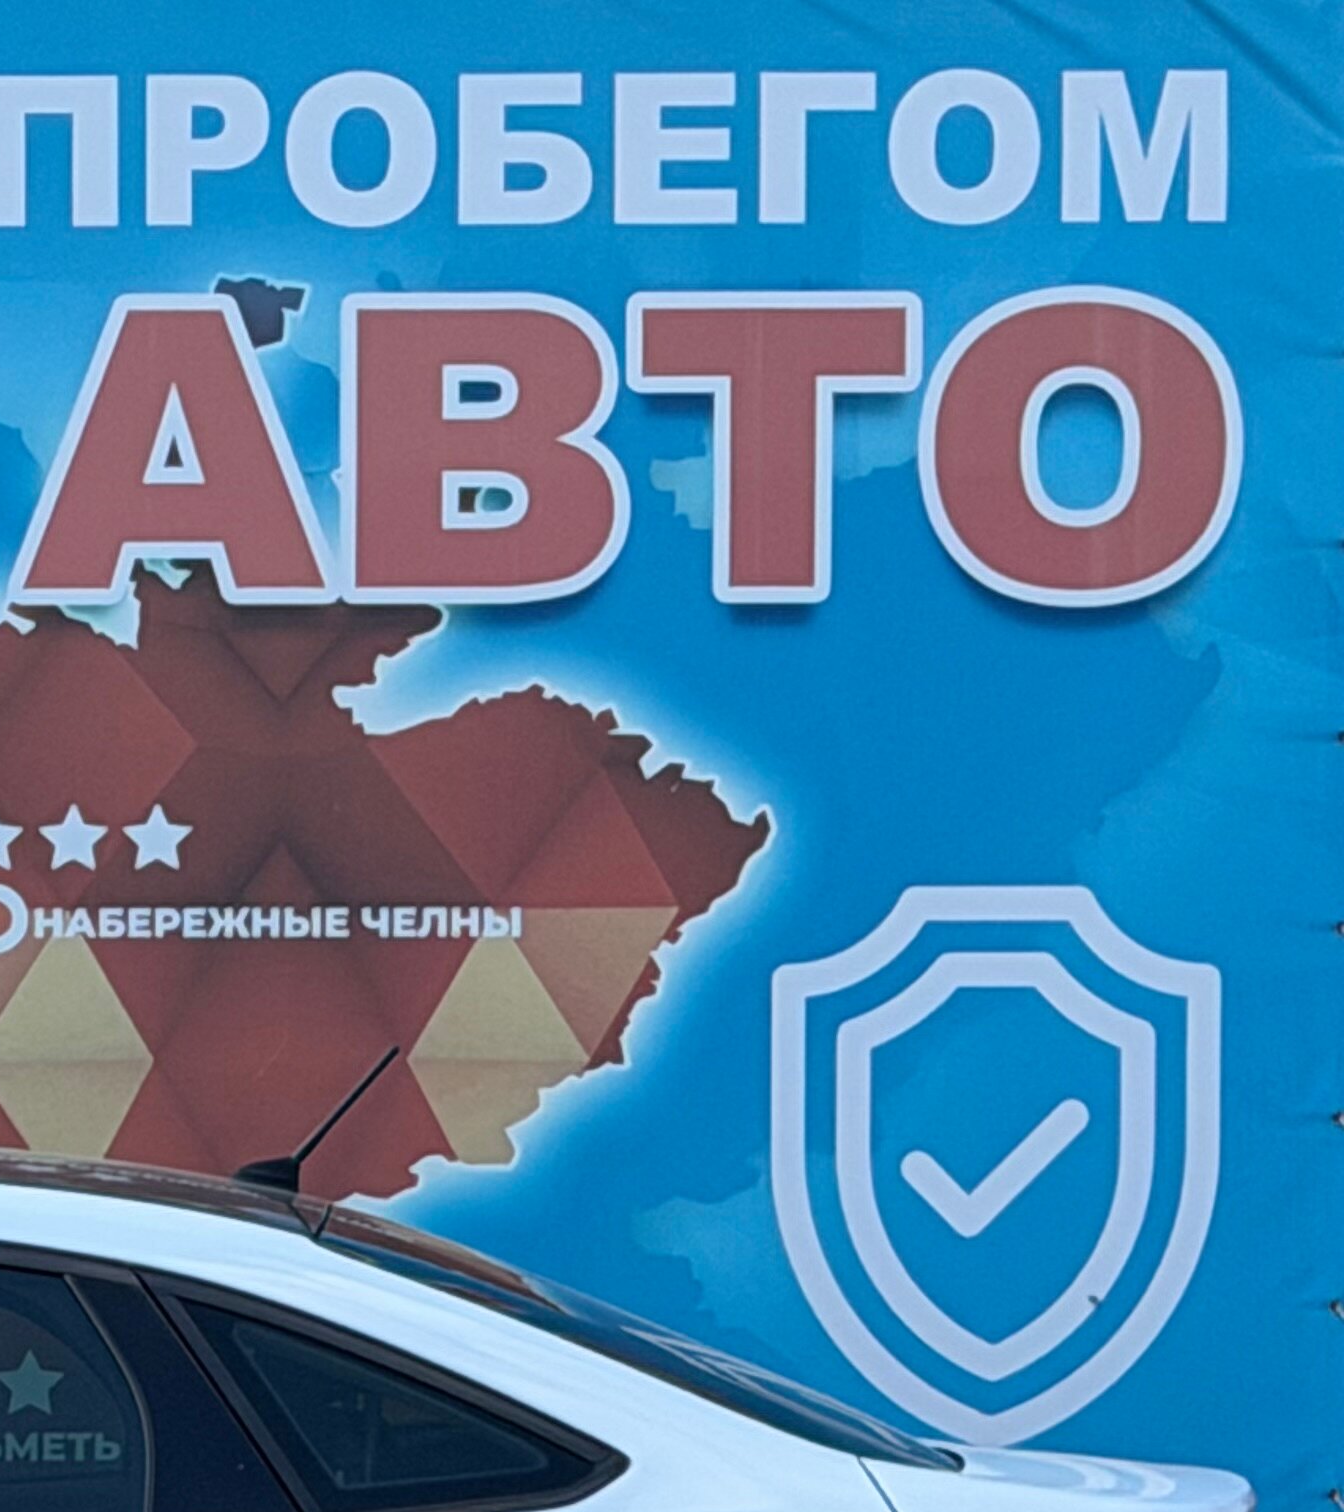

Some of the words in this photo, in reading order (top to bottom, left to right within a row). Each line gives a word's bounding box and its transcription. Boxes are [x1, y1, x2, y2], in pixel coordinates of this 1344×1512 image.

[12, 287, 1246, 610] АВТО
[32, 906, 350, 940] НАБЕРЕЖНЫЕ
[361, 906, 523, 940] ЧЕЛНЫ
